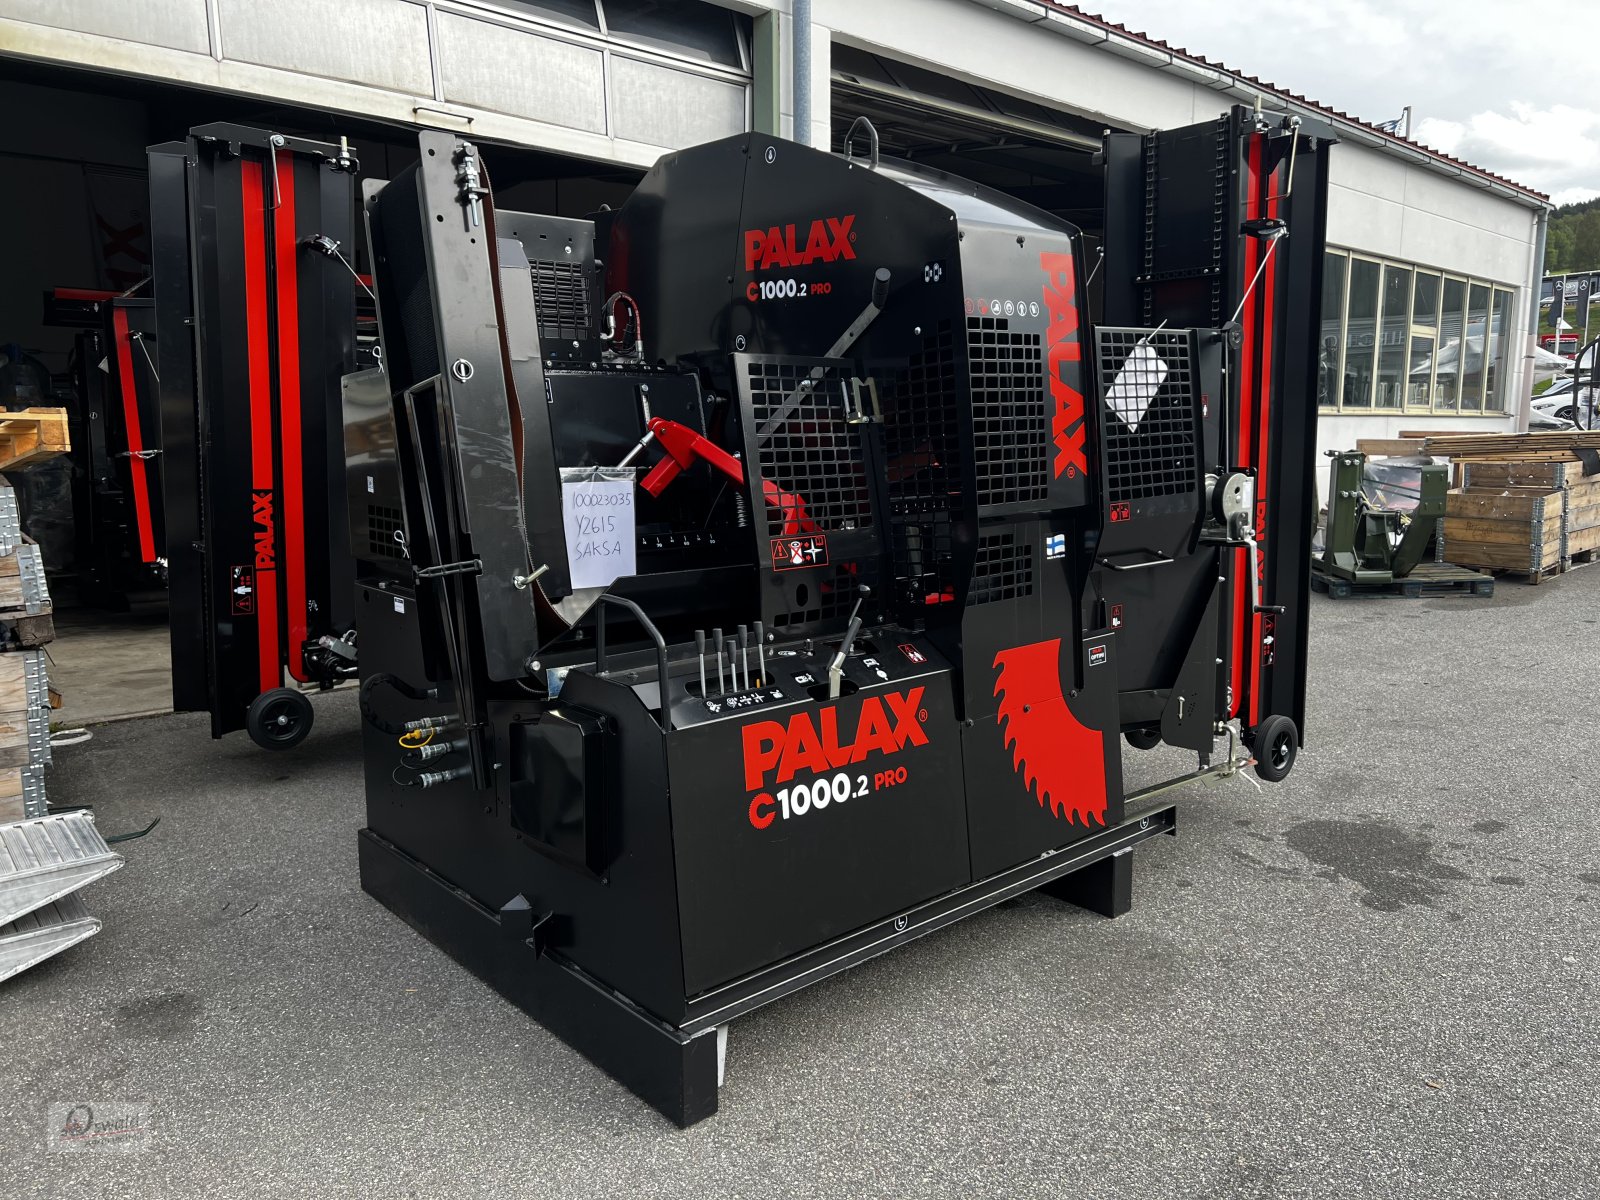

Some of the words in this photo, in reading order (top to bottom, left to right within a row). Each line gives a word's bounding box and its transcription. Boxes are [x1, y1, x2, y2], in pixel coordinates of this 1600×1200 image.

[810, 282, 832, 295] PRO
[573, 491, 632, 509] 100023035
[575, 515, 617, 538] Y2615
[575, 541, 622, 561] SAKSA
[873, 765, 908, 791] PRO
